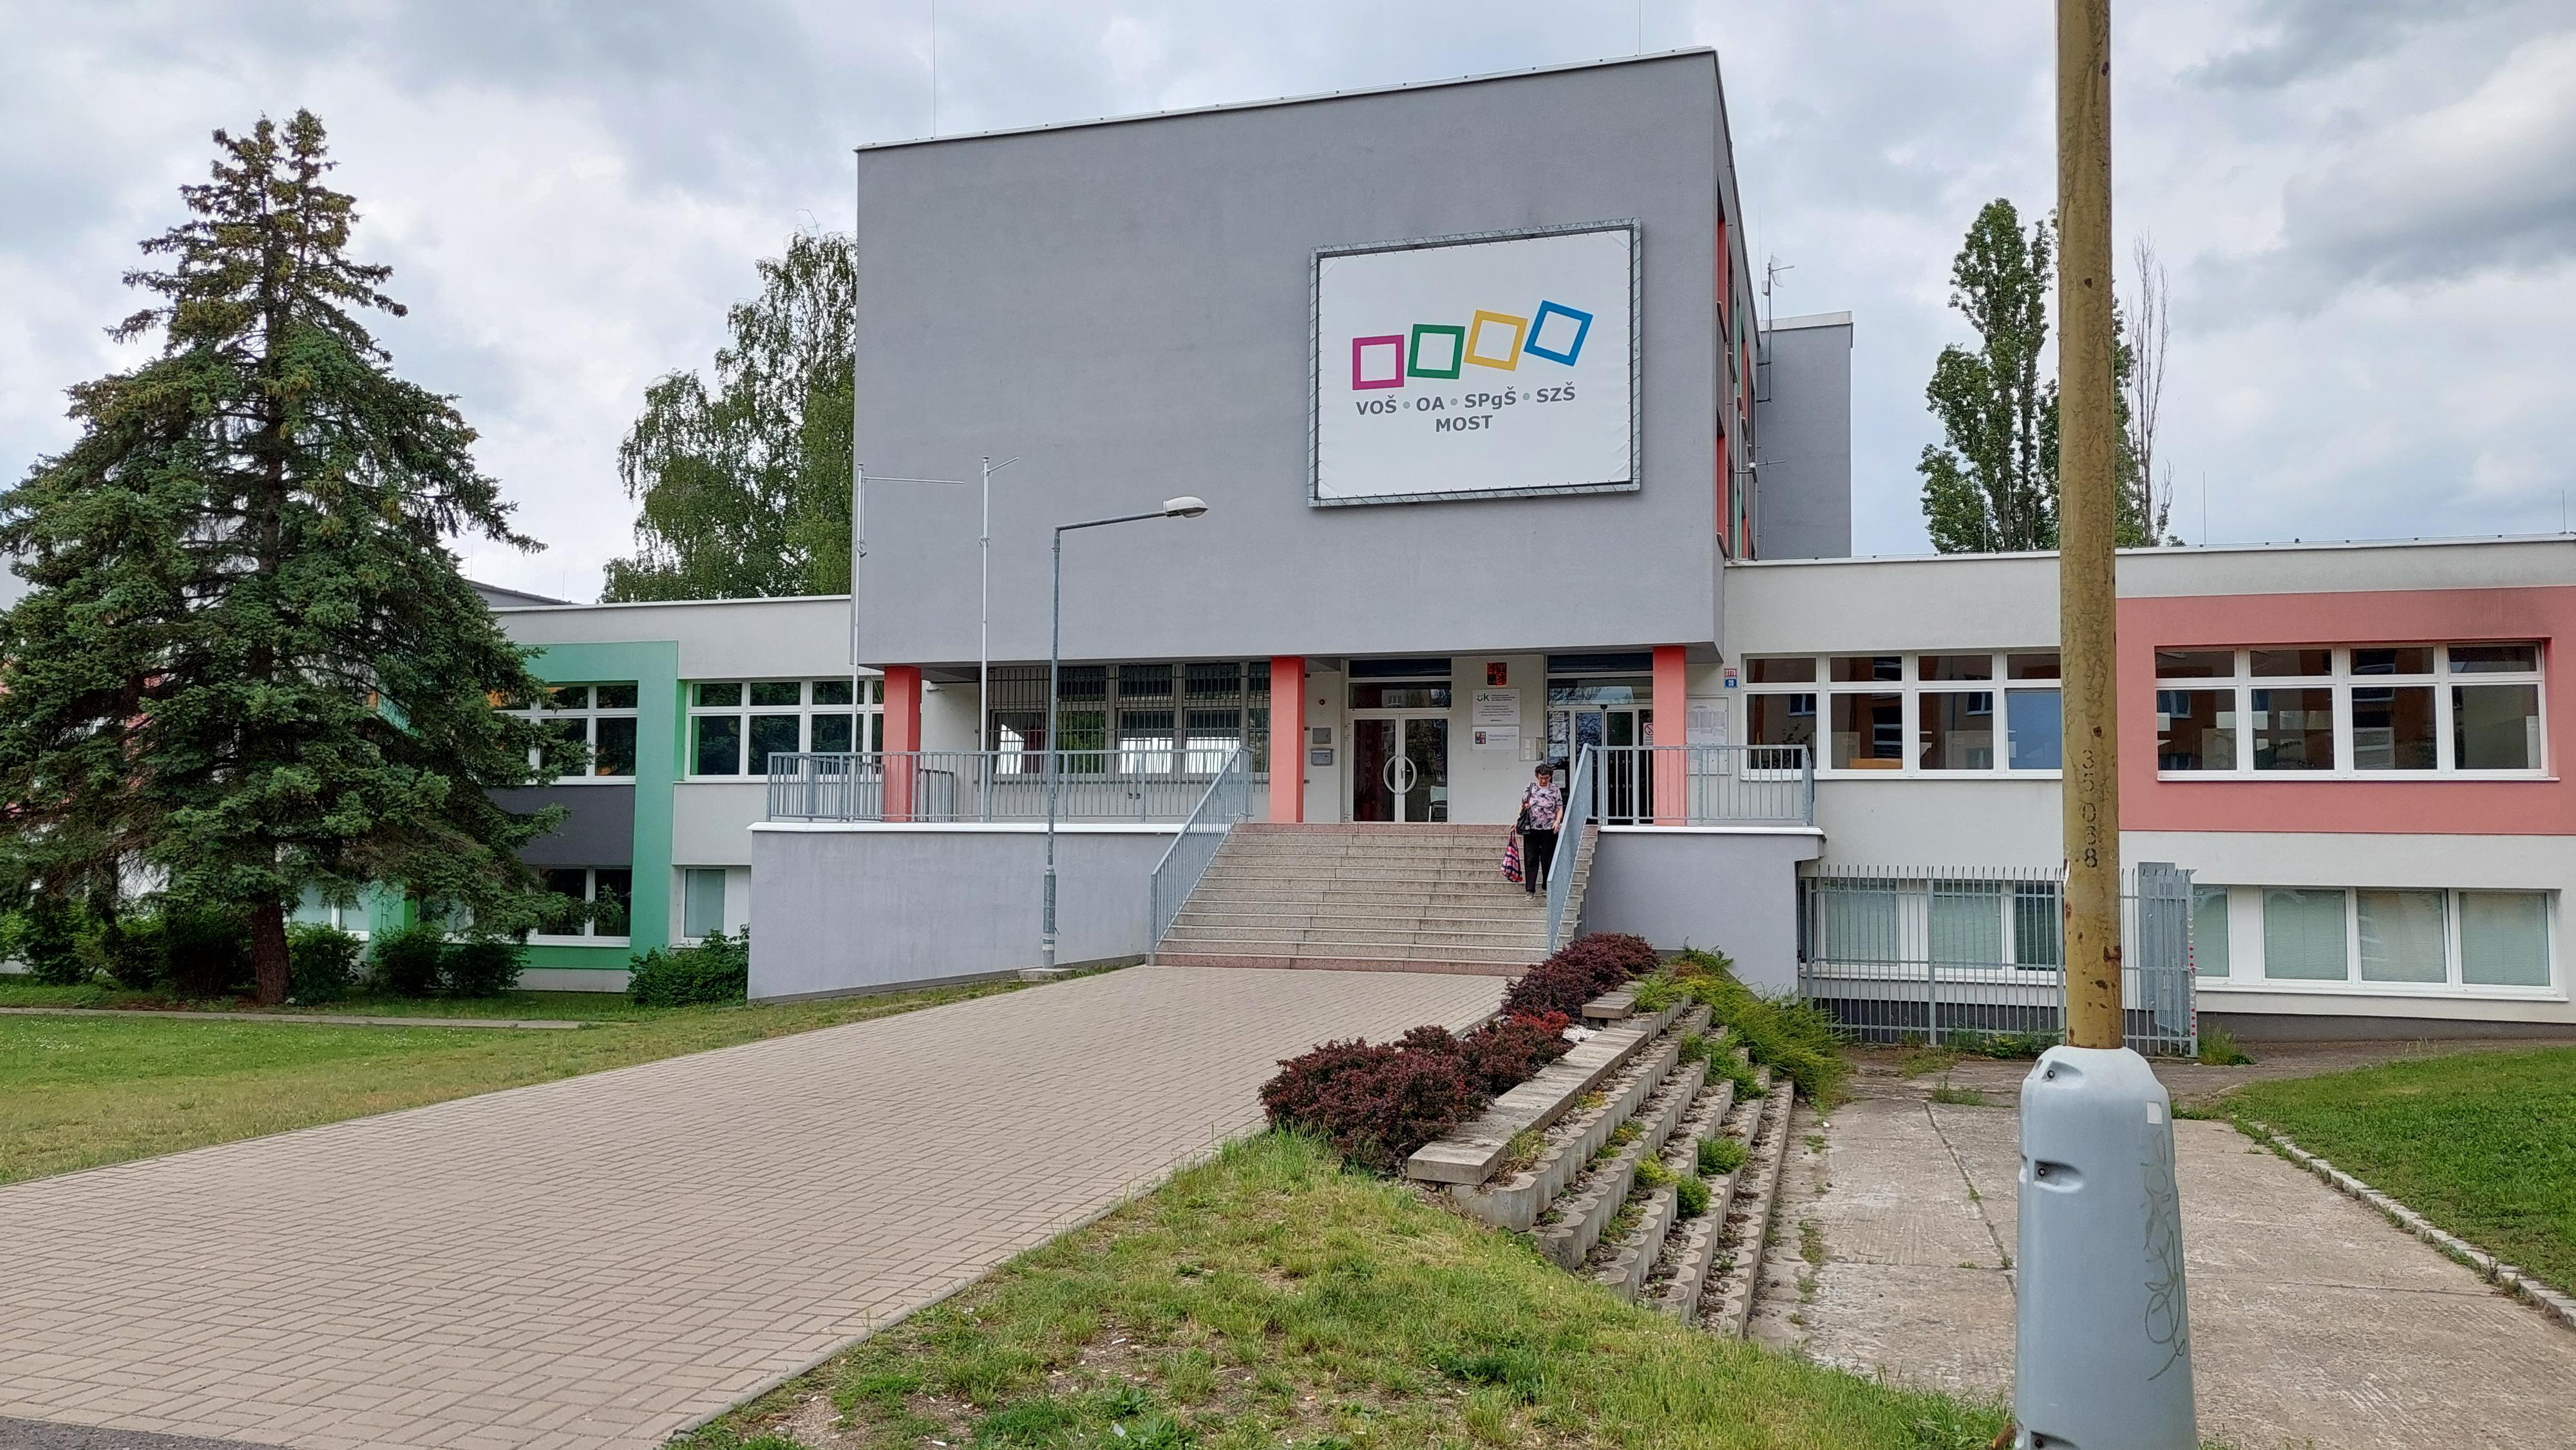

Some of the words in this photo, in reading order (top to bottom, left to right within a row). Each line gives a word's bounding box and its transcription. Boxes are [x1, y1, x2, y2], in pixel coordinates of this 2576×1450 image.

[1356, 395, 1397, 415] VOŠ
[1416, 397, 1445, 411] OA
[1464, 386, 1517, 410] SPgŠ
[1536, 381, 1576, 403] SZŠ
[1435, 415, 1493, 433] MOST
